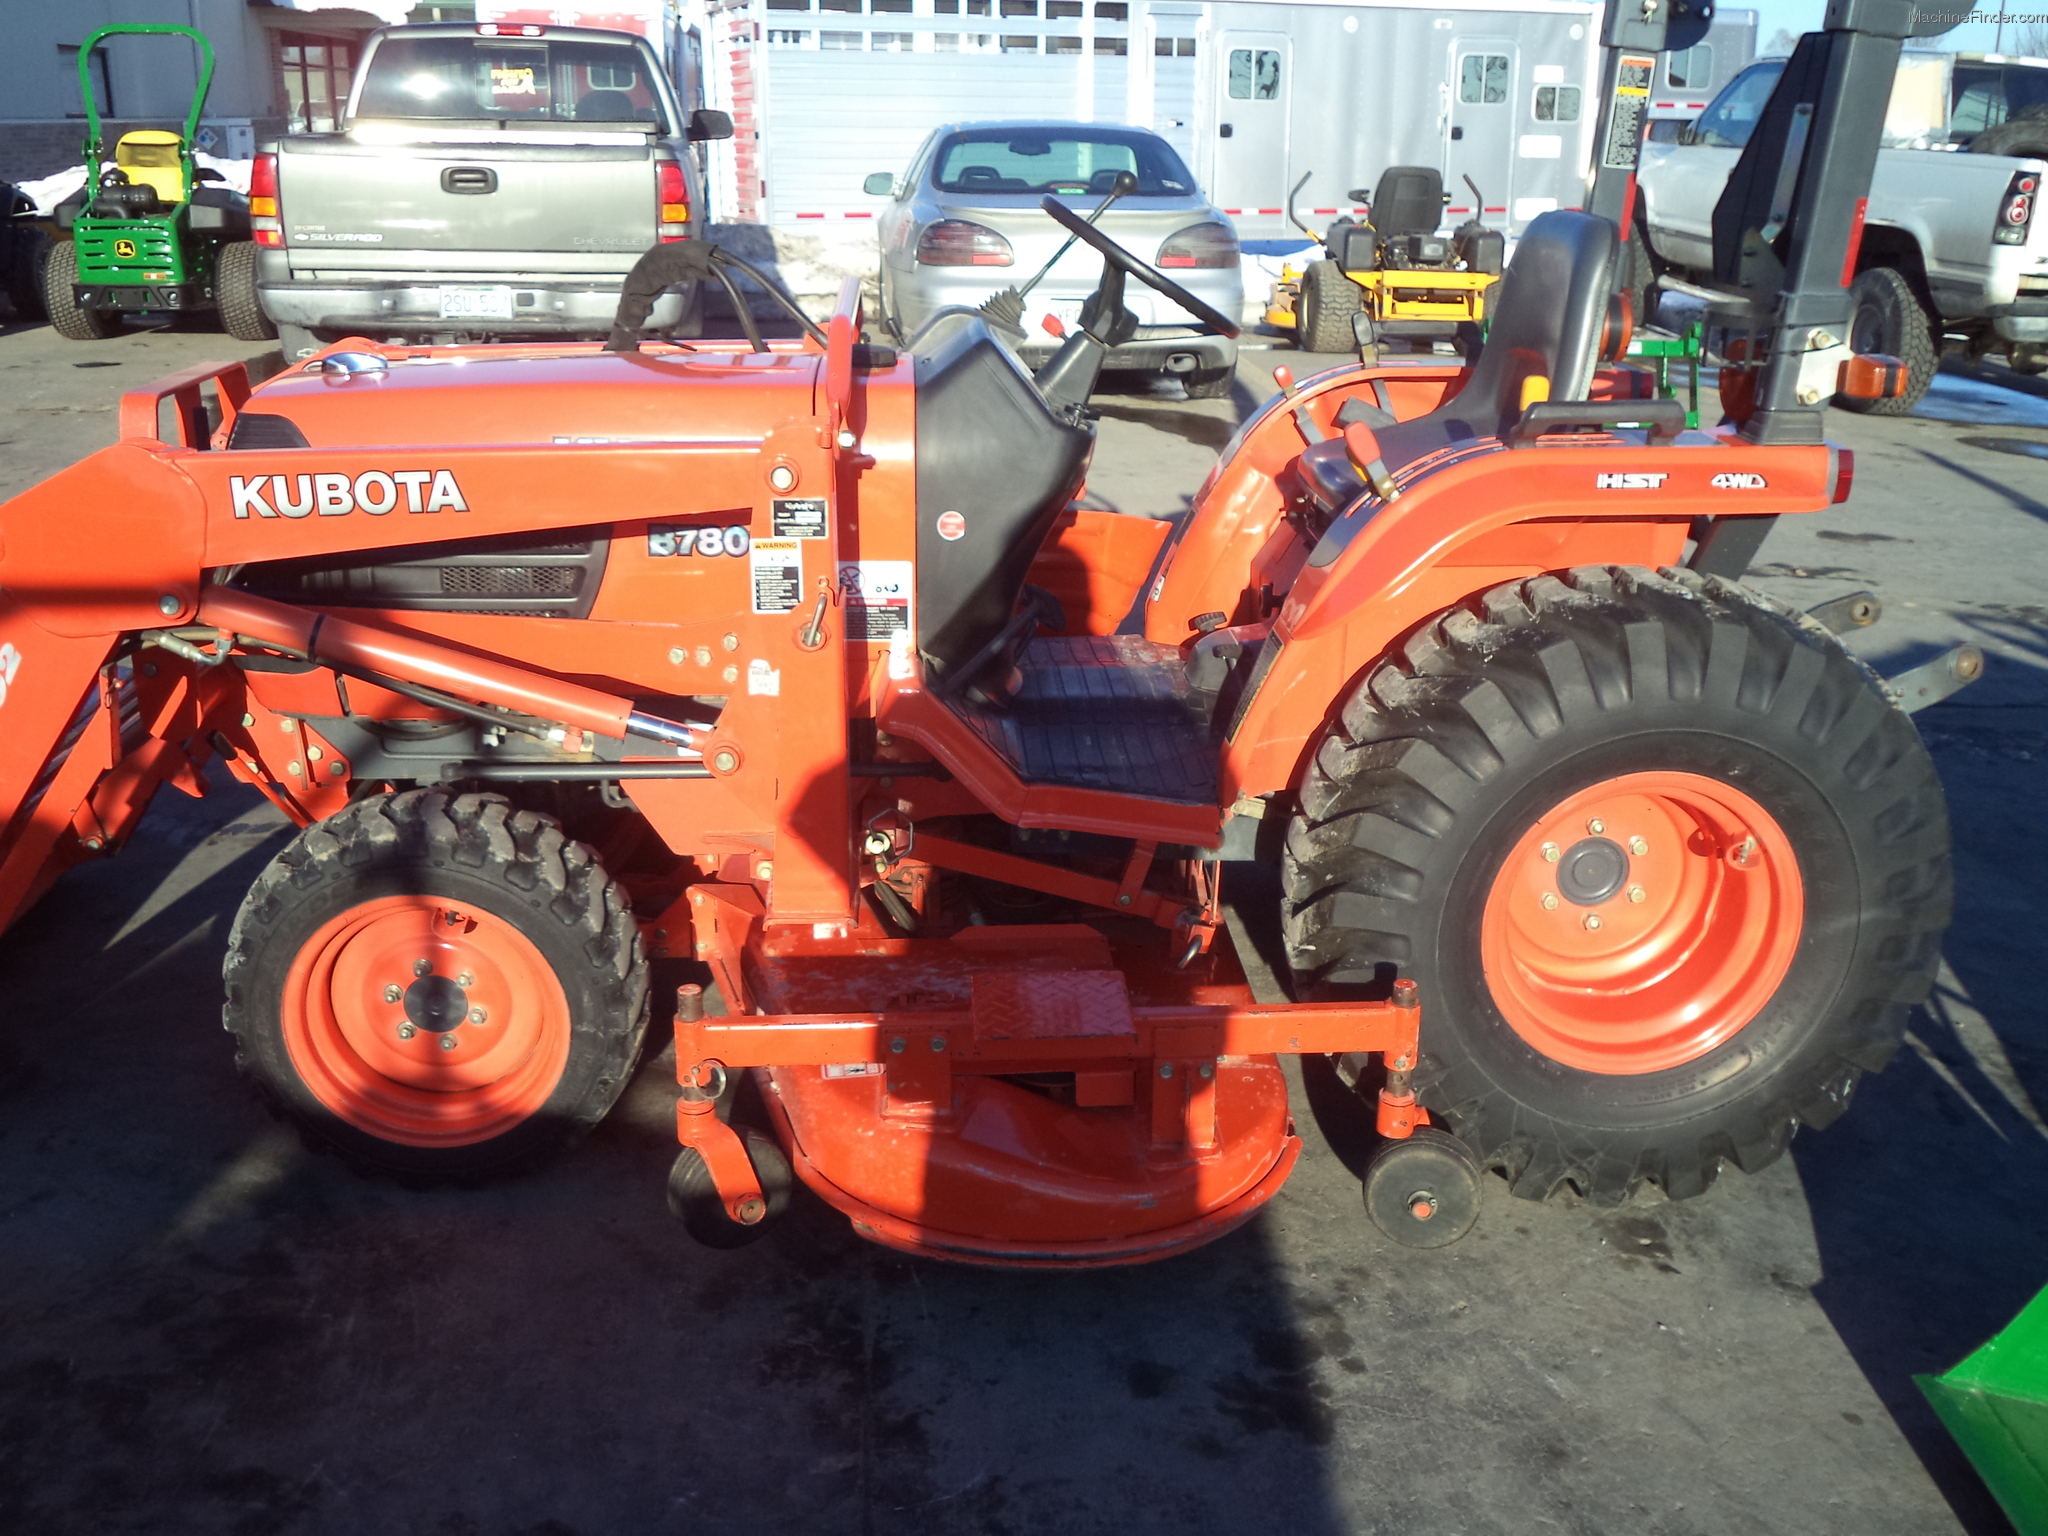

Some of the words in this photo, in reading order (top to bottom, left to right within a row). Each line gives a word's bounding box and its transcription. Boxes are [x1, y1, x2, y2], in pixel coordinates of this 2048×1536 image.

[309, 233, 383, 242] SILVERADO
[573, 237, 648, 246] CHEVROLET
[1596, 473, 1669, 489] HST
[1710, 473, 1768, 489] 4WD
[229, 469, 470, 519] KUBOTA
